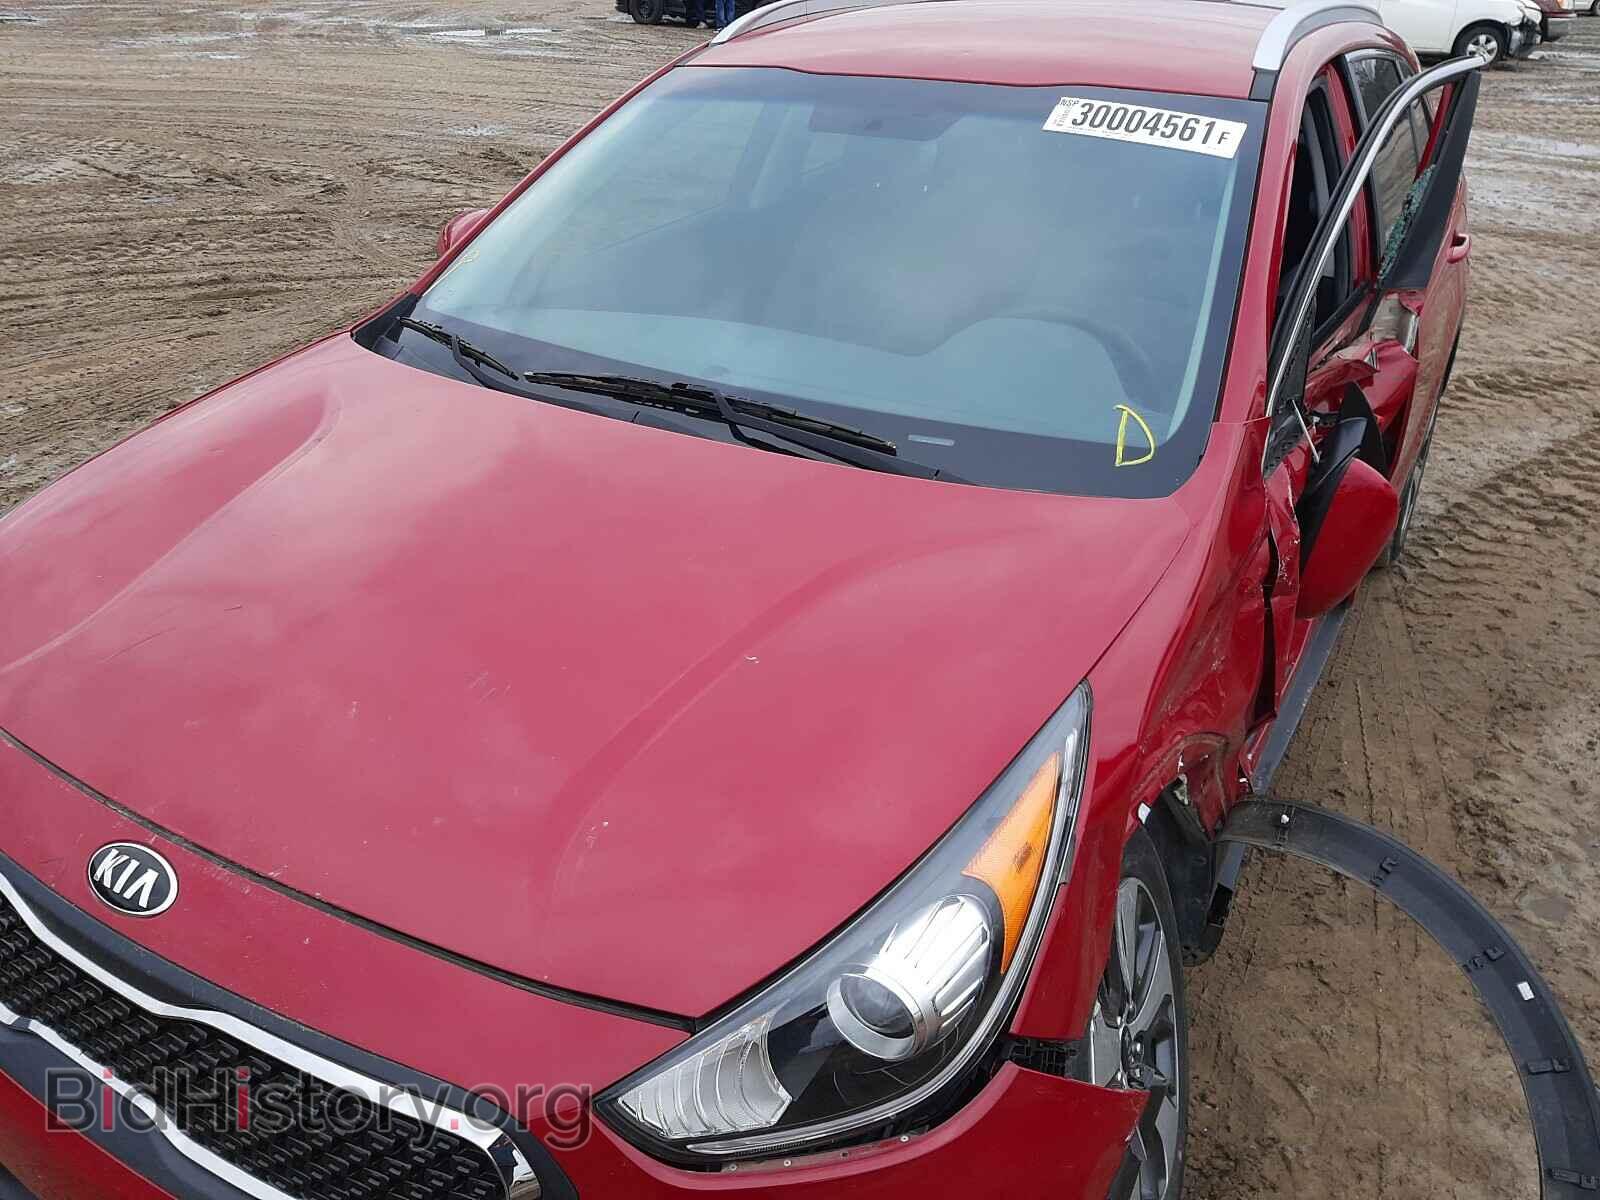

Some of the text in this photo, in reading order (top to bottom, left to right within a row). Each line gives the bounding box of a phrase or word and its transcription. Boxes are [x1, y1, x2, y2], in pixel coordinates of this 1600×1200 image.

[1072, 102, 1217, 145] 30004561
[1217, 131, 1231, 145] F
[1112, 404, 1156, 467] D
[93, 847, 159, 909] KIA
